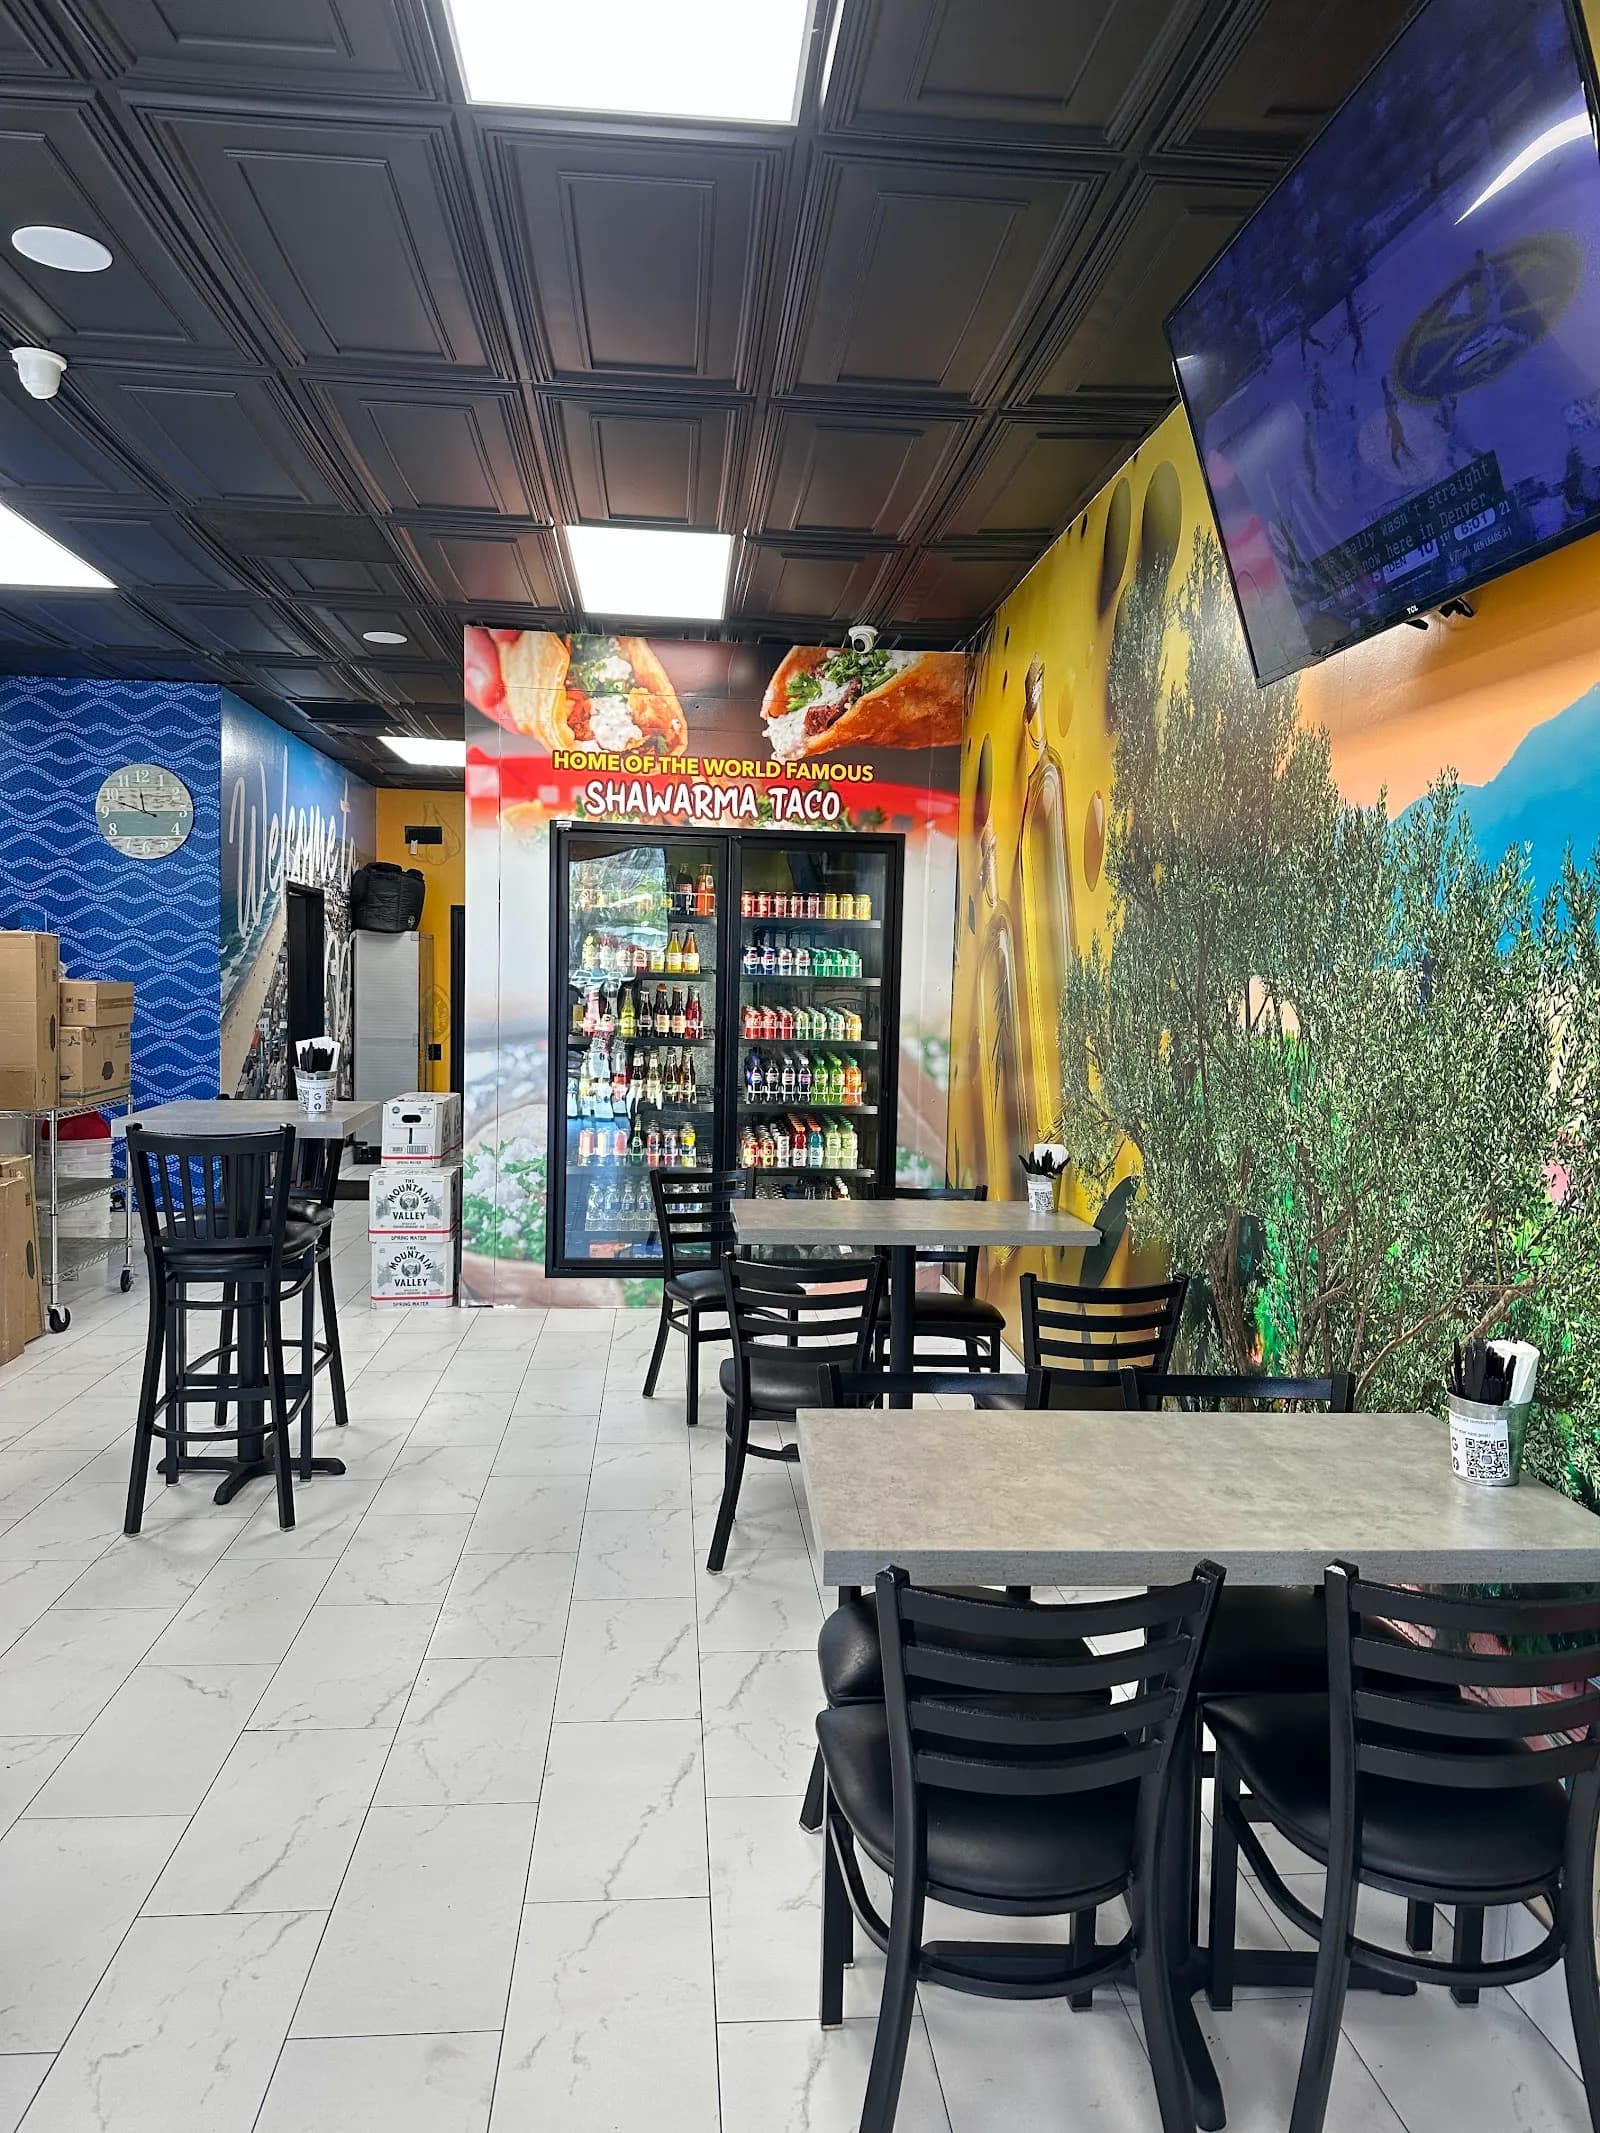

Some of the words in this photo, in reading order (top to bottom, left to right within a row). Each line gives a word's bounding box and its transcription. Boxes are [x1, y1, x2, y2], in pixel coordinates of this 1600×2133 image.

[1340, 531, 1376, 560] really
[1382, 503, 1422, 536] wasn't
[1428, 461, 1490, 510] straight
[1418, 542, 1434, 557] 10
[1460, 511, 1488, 535] 6:01
[1498, 500, 1512, 516] 21
[1385, 535, 1414, 559] here
[1420, 522, 1435, 540] in
[1406, 604, 1419, 615] TCL
[553, 751, 620, 772] HOME
[624, 754, 657, 773] OF
[660, 756, 699, 775] THE
[703, 758, 781, 778] WORLD
[785, 761, 874, 783] FAMOUS
[119, 775, 129, 787] 11
[134, 769, 150, 783] 12
[584, 779, 759, 820] SHAWARMA
[767, 786, 841, 821] TACO
[101, 806, 110, 818] 9
[108, 822, 117, 836] 8
[170, 822, 181, 836] 4
[387, 1183, 432, 1204] MOUNTAIN
[392, 1211, 426, 1220] VALLEY
[389, 1250, 434, 1270] MOUNTAIN
[394, 1278, 428, 1287] VALLEY
